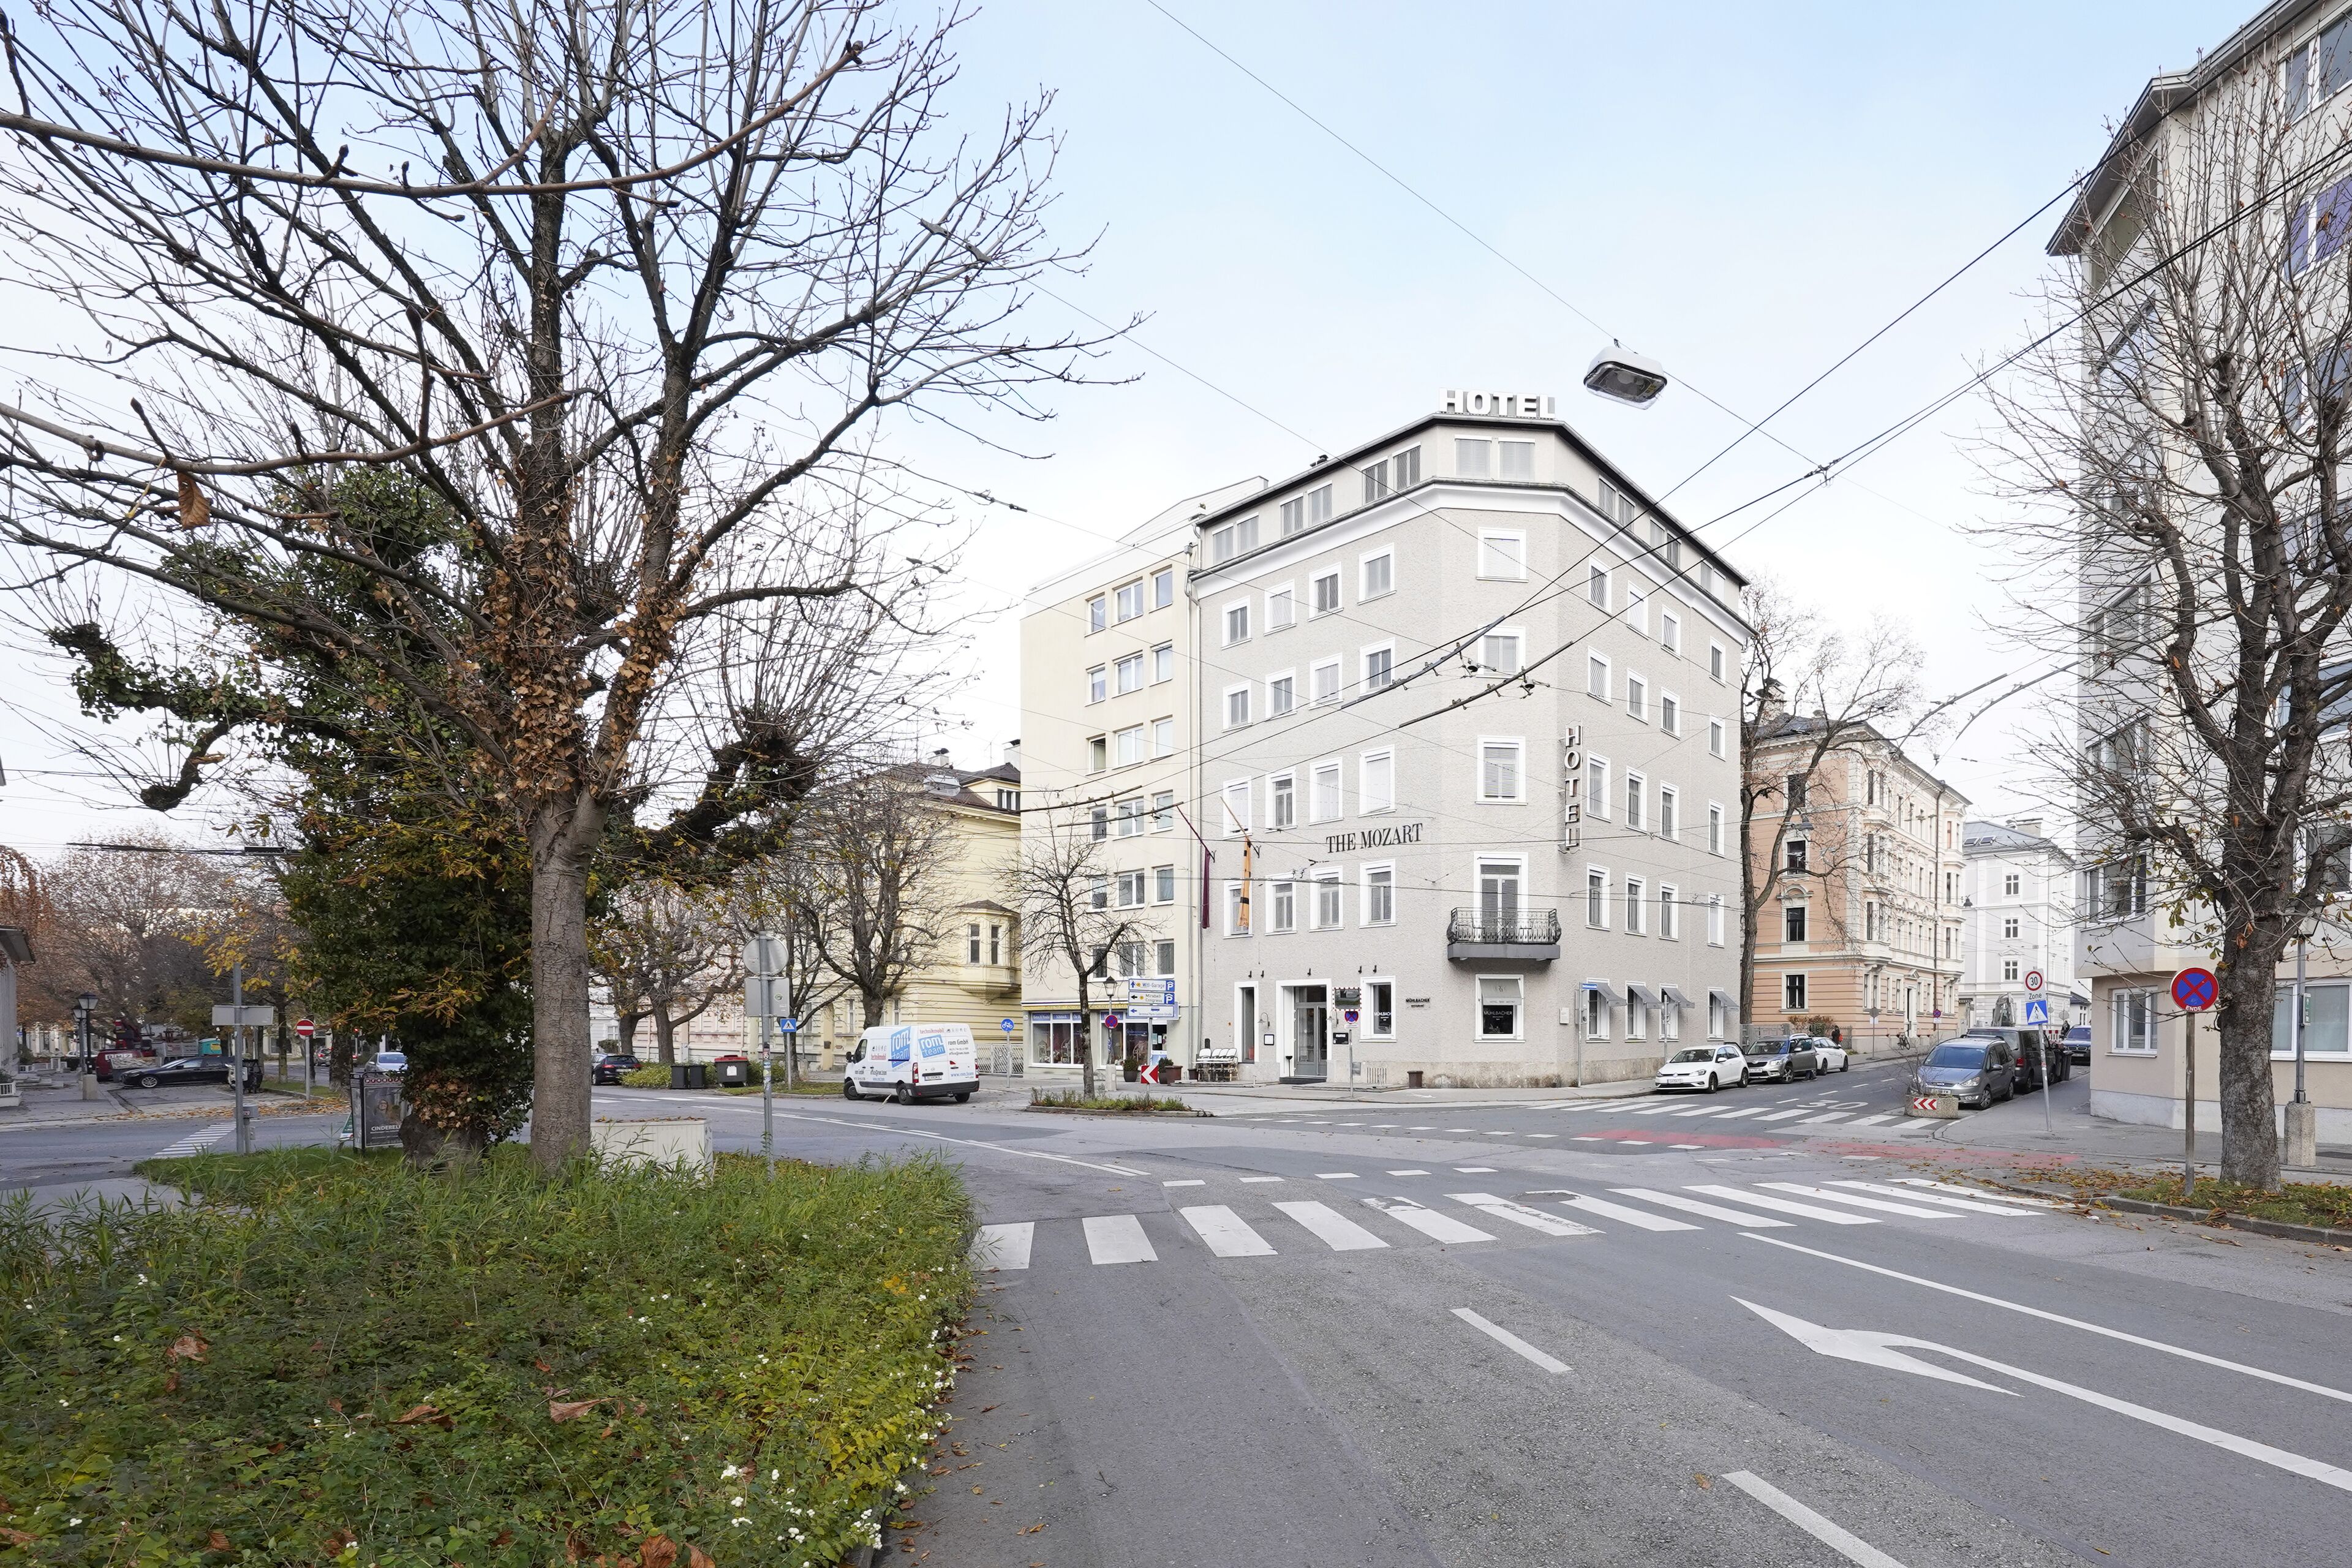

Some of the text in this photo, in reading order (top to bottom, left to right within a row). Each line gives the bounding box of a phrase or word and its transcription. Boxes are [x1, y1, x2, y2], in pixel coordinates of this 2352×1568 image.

[1439, 387, 1556, 418] HOTEL
[1564, 725, 1581, 848] HOTEL
[1325, 823, 1423, 853] THE MOZART
[2030, 976, 2038, 986] 30
[1796, 1099, 1869, 1109] 30
